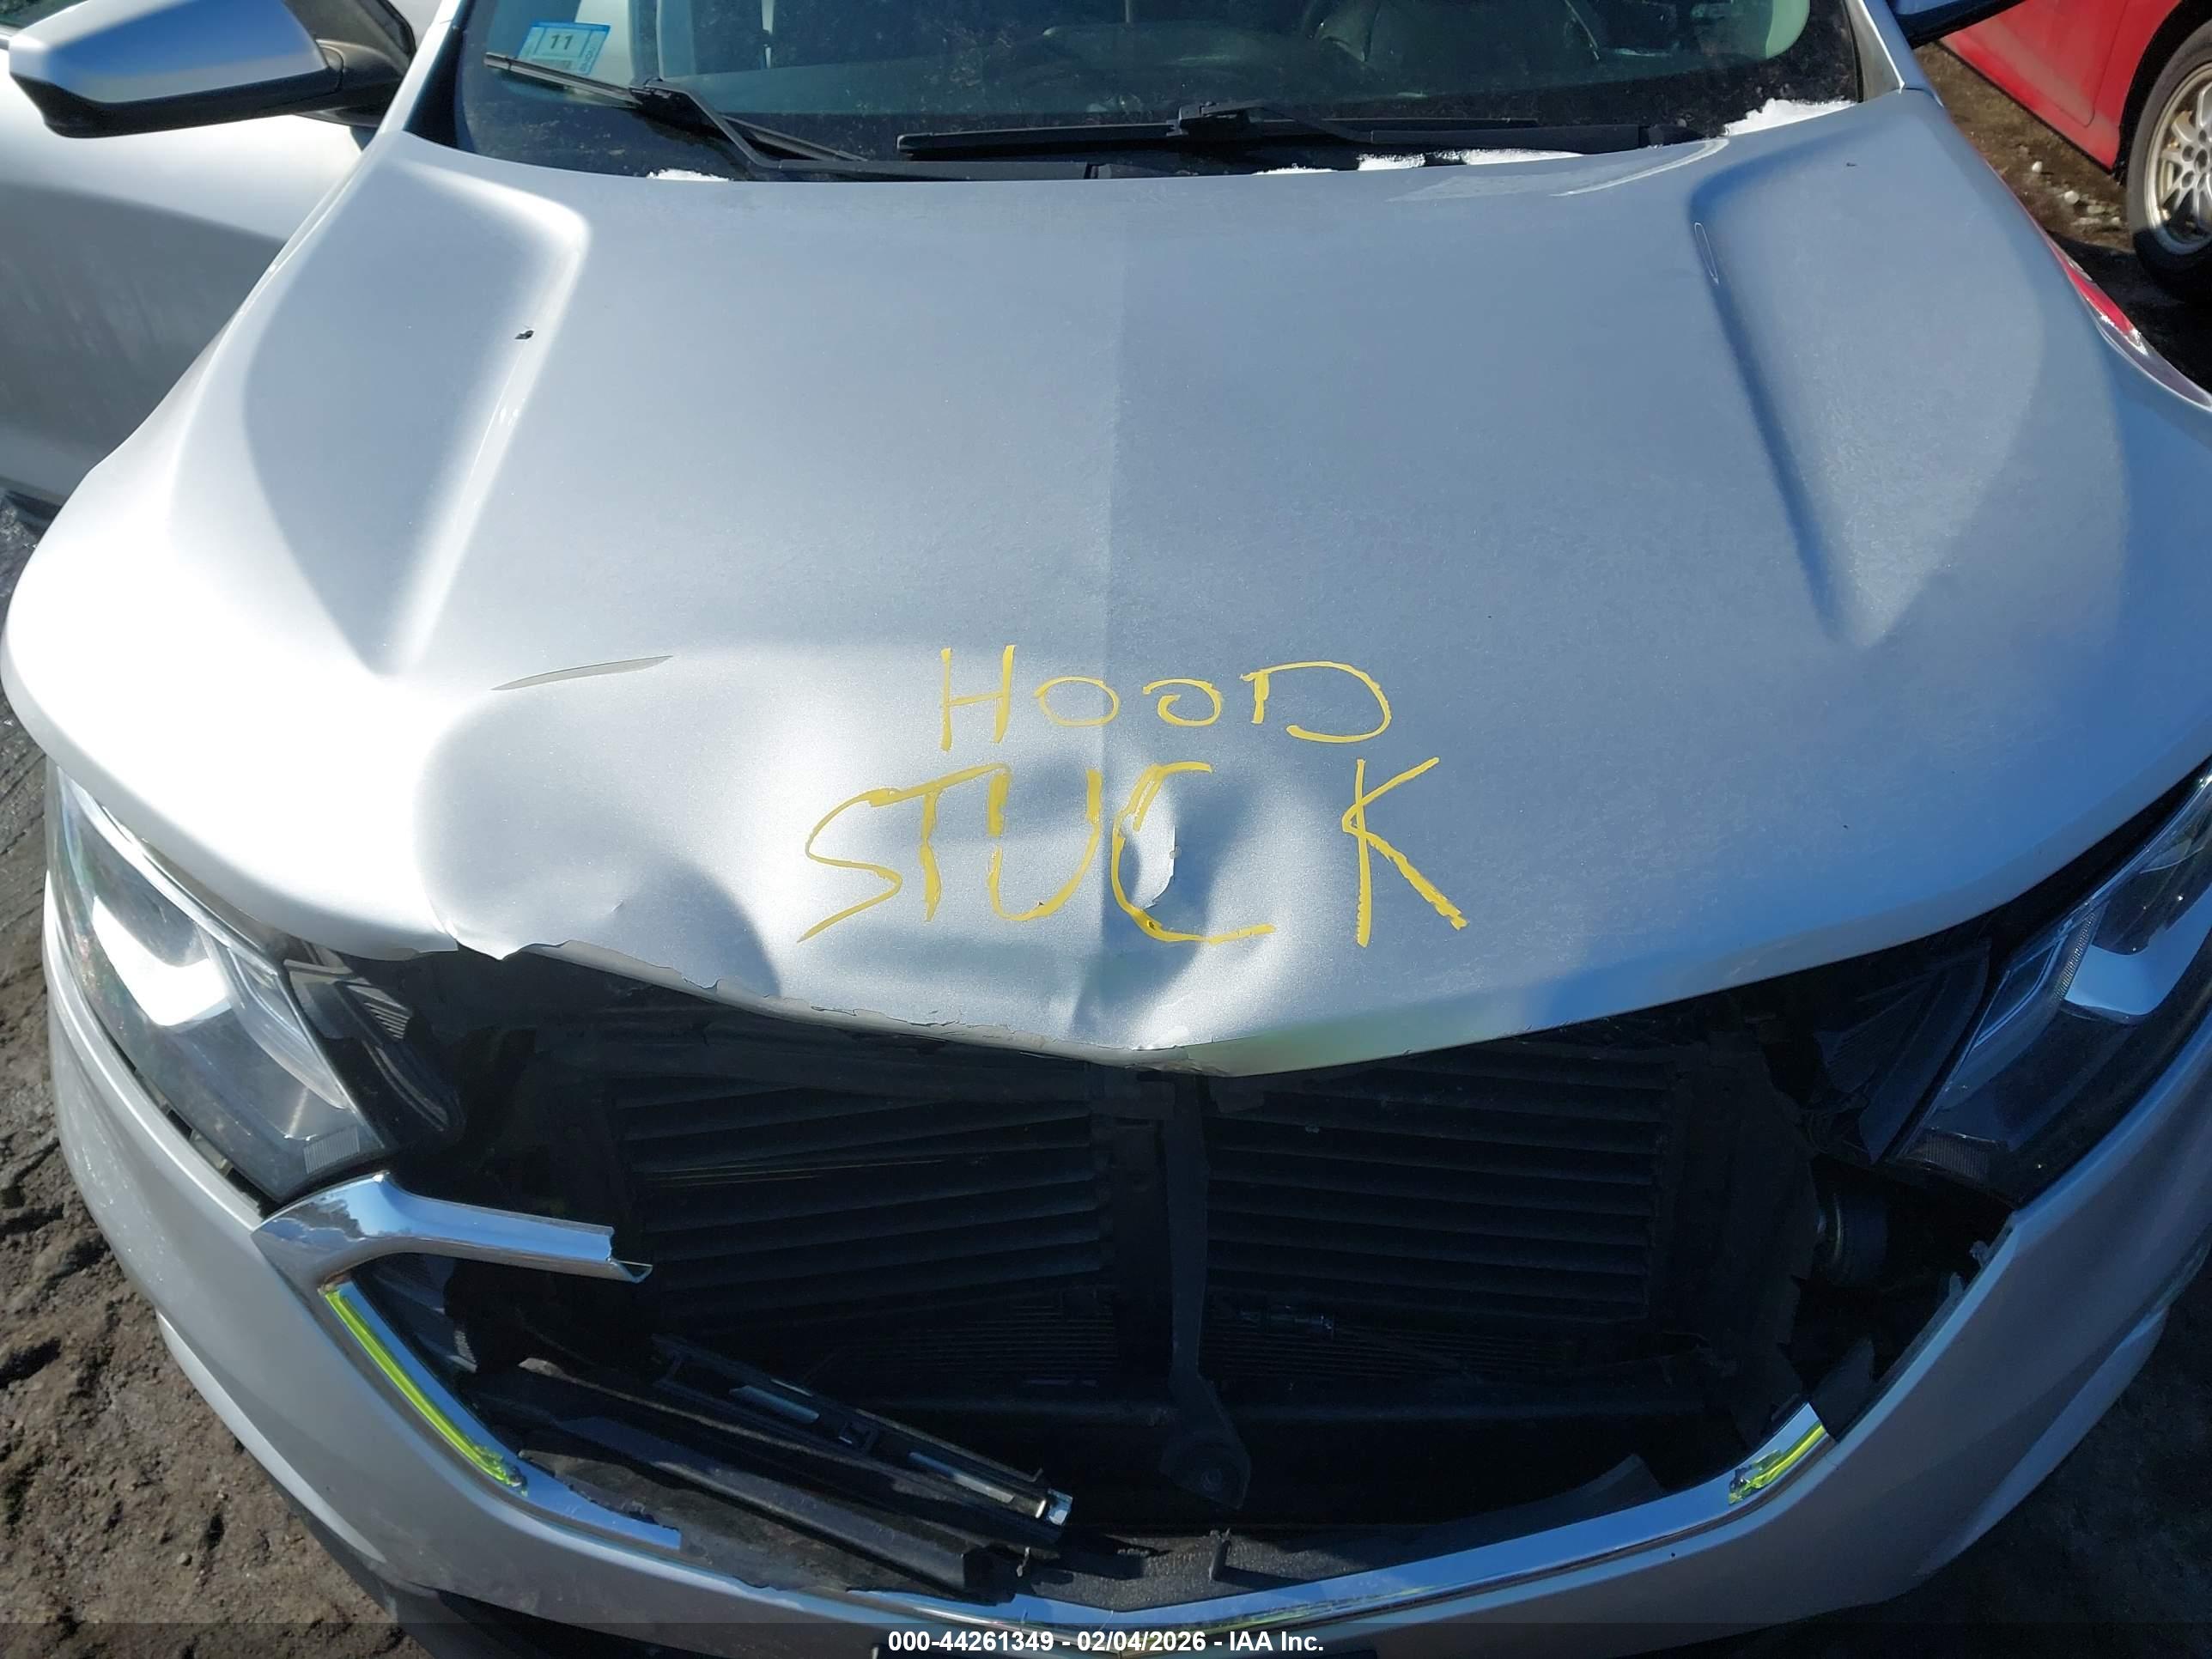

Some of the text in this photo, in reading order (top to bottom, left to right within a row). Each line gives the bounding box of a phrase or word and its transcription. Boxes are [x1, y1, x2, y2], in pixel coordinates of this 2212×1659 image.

[550, 33, 574, 50] 11
[940, 644, 1392, 752] HOOD
[797, 757, 1469, 947] STUCK
